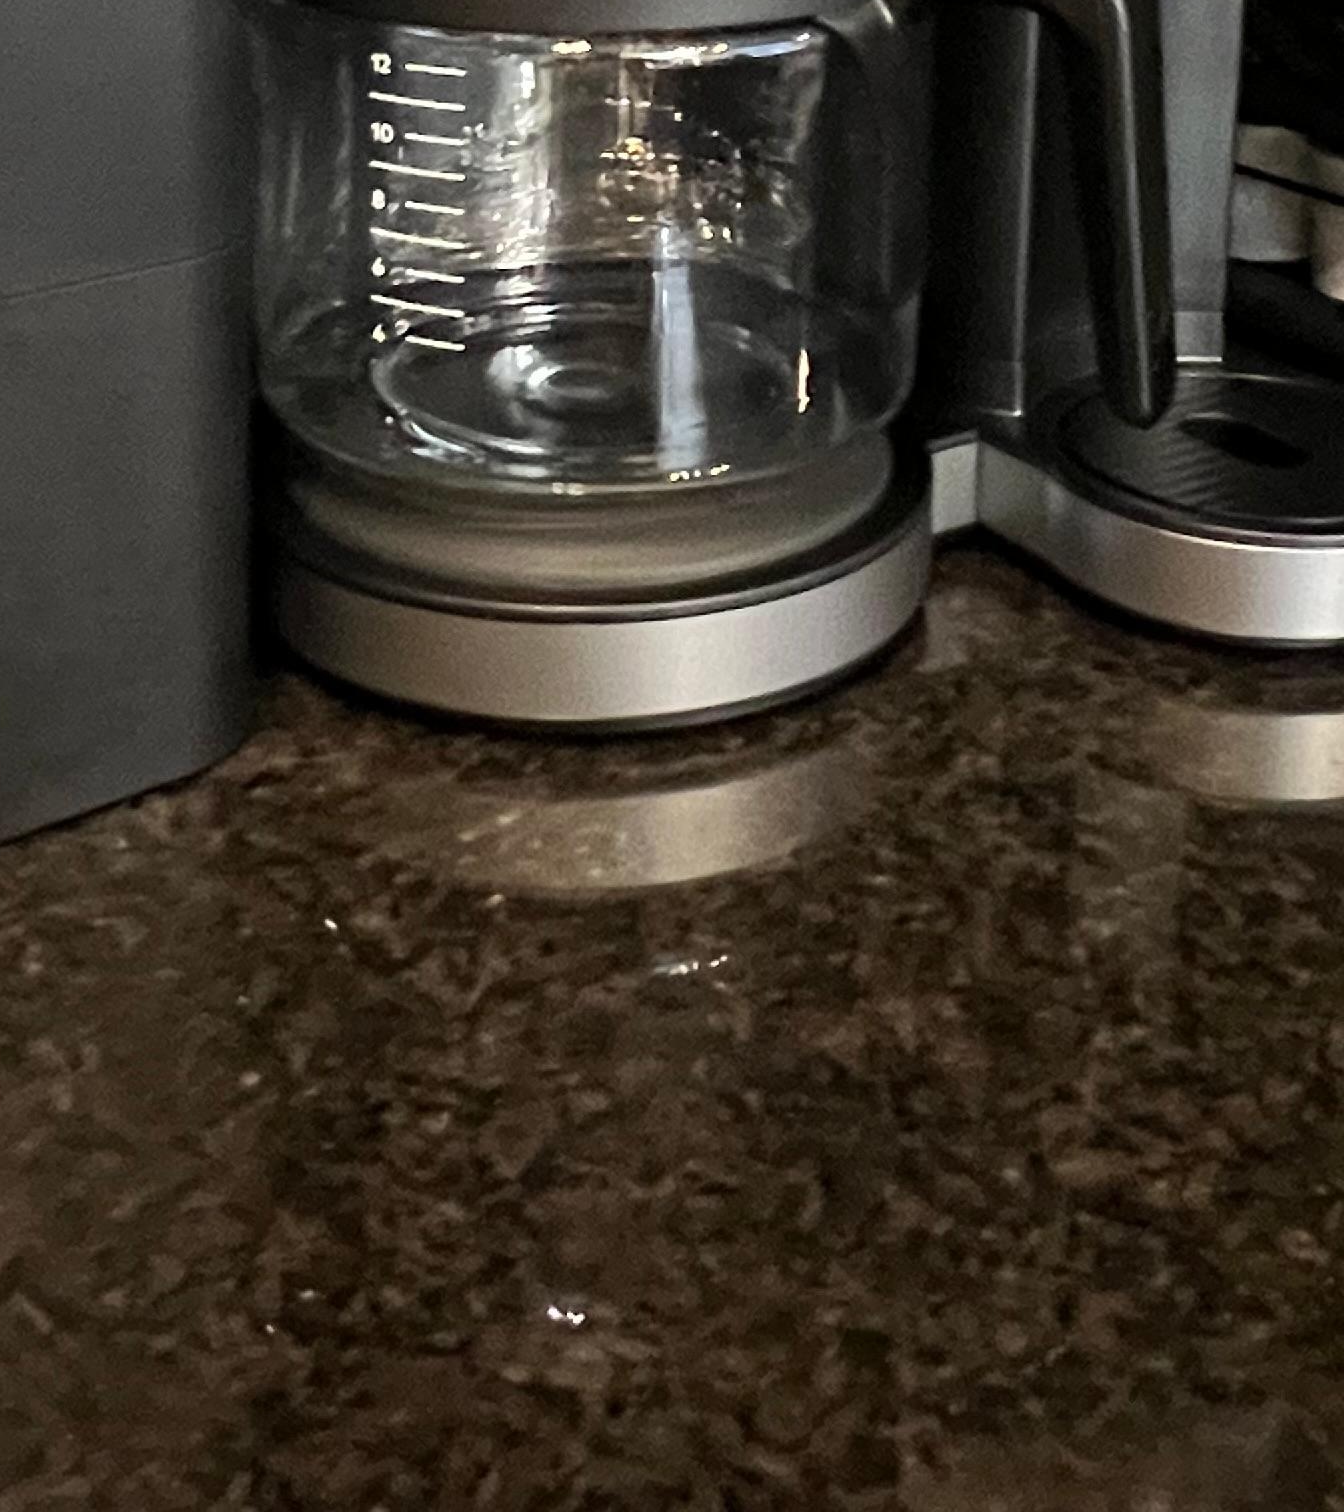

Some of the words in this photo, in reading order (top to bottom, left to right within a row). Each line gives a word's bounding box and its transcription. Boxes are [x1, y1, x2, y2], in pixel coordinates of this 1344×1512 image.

[370, 52, 392, 75] 12
[370, 121, 394, 144] 10
[371, 188, 386, 210] 8
[371, 256, 386, 277] 6
[372, 323, 386, 343] 4
